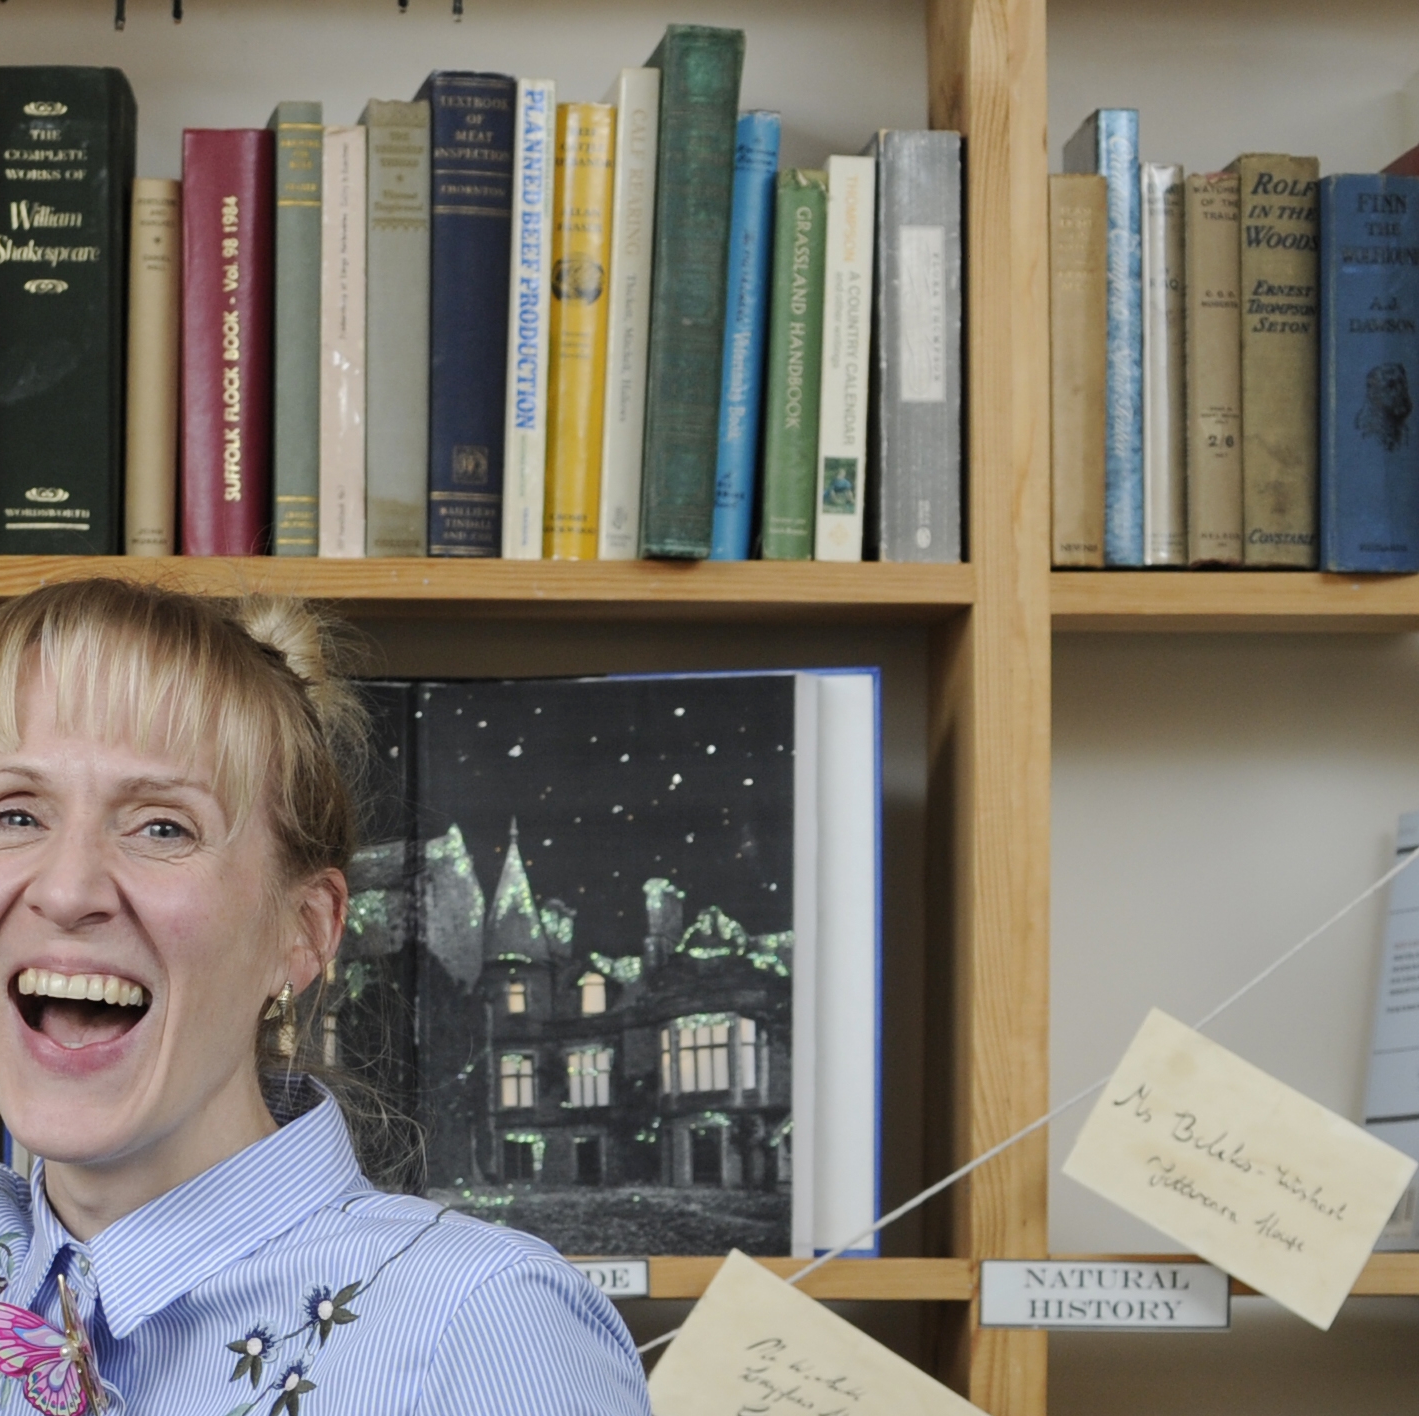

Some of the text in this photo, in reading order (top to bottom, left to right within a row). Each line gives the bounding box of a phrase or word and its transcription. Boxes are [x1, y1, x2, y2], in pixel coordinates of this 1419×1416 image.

[440, 95, 510, 110] TEXTBOOK
[466, 113, 486, 125] OF
[29, 129, 62, 141] THE
[454, 130, 495, 144] MEAT
[3, 148, 88, 161] COMPLETE
[434, 146, 510, 162] INSPECTION
[4, 168, 87, 181] WORKS OF
[440, 184, 506, 197] THORNTON
[1251, 172, 1317, 198] ROLF
[1356, 193, 1408, 214] FINN
[10, 199, 83, 231] William
[1248, 205, 1314, 222] IN THE
[1245, 225, 1318, 250] WOODS
[1365, 222, 1402, 237] THE
[511, 87, 547, 430] PLANNED BEEF PRODUCTION
[1252, 280, 1314, 298] ERNEST
[841, 174, 860, 446] THOMPSON A COUNTRY CALENDAR
[1246, 298, 1318, 315] THOMPSON
[782, 205, 815, 430] GRASSLAND HANDBOOK
[1252, 317, 1311, 334] SETON
[220, 195, 242, 501] SUFFOLK FLOCK BOOK Vol. 98 1984
[1023, 1266, 1191, 1292] NATURAL
[1028, 1298, 1185, 1322] HISTORY
